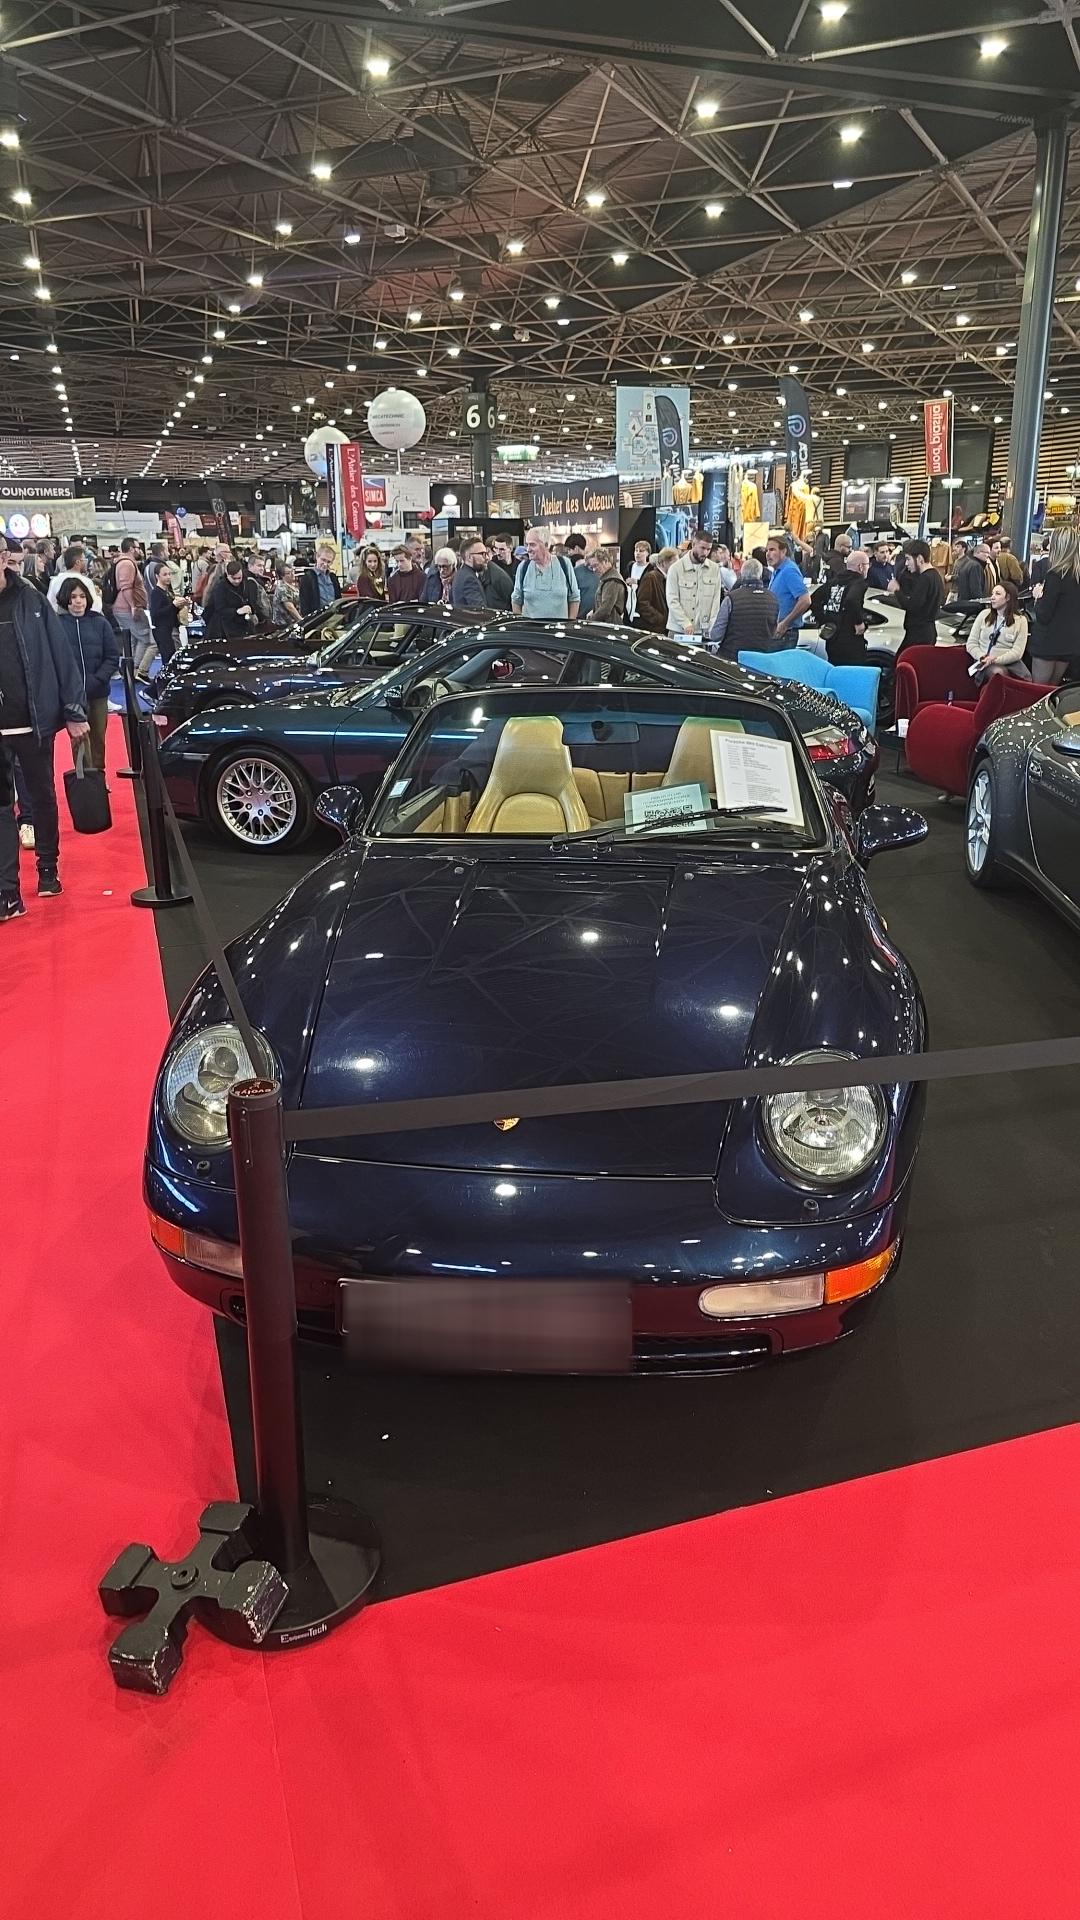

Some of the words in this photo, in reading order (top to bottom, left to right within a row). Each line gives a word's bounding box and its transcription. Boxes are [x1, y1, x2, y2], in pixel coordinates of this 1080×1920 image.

[466, 404, 480, 428] 6
[487, 406, 495, 429] 6
[346, 448, 357, 482] L'Atelier
[0, 487, 71, 497] OUNGTIMERS
[256, 490, 263, 500] 6
[350, 485, 358, 499] des
[364, 490, 384, 503] SIMCA
[533, 490, 563, 516] L'Atelier
[565, 488, 579, 514] des
[582, 487, 615, 512] Coteaux
[351, 501, 360, 531] Coteaux
[712, 481, 727, 542] L'Atelier
